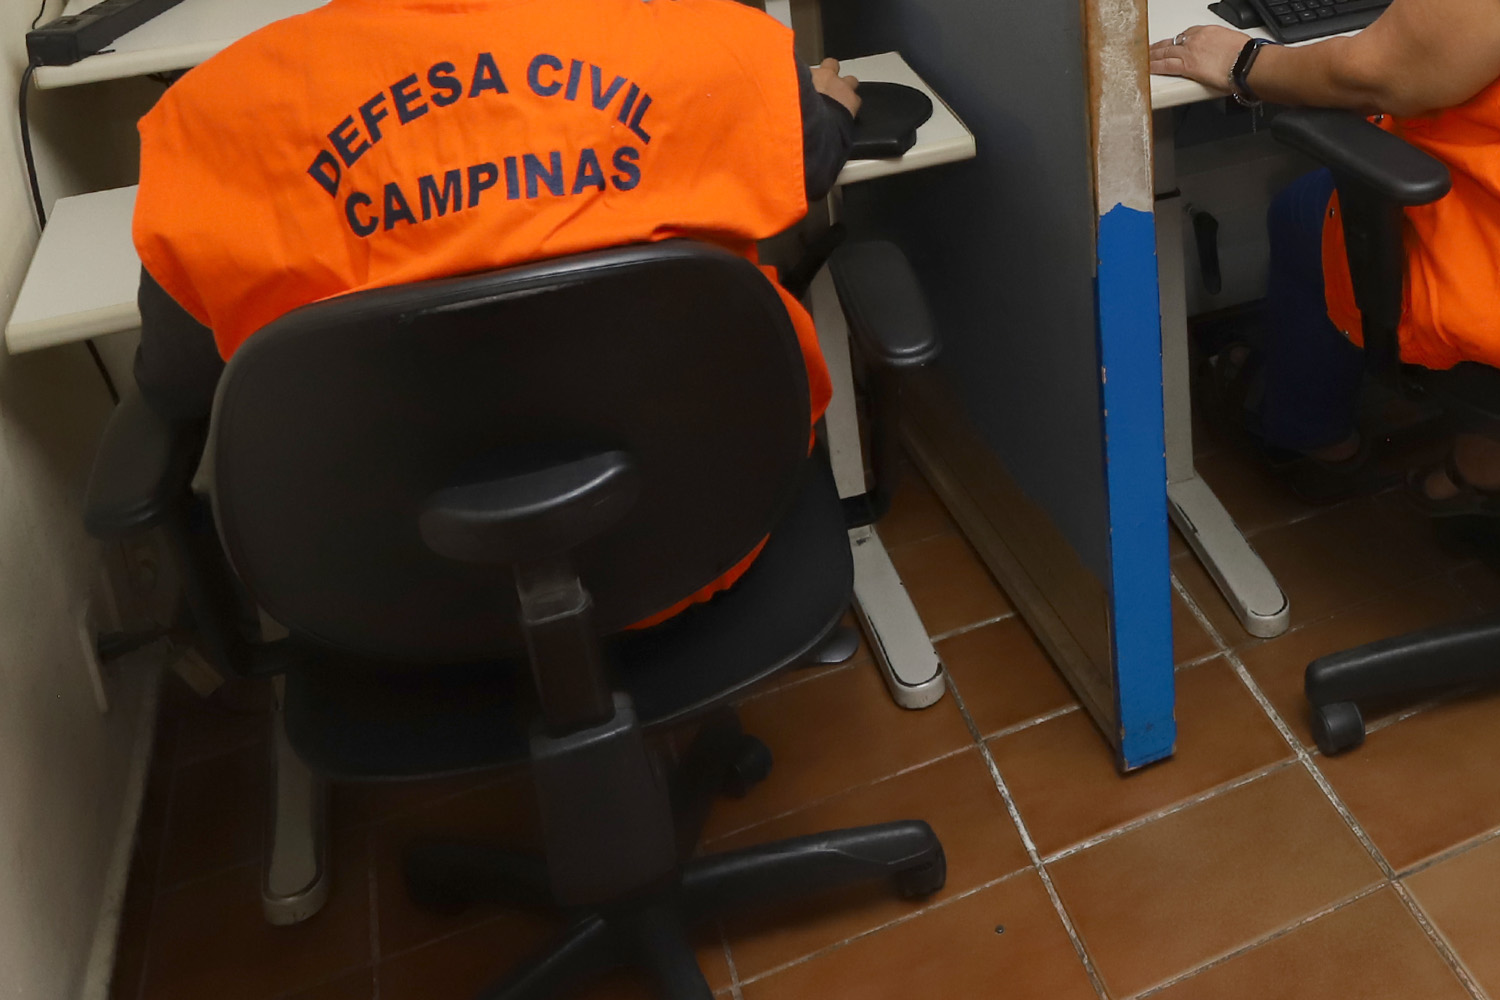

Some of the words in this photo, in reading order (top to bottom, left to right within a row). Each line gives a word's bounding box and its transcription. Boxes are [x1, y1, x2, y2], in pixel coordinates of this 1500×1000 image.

[306, 51, 509, 198] DEFESA
[526, 53, 653, 145] CIVIL
[344, 146, 641, 238] CAMPINAS
